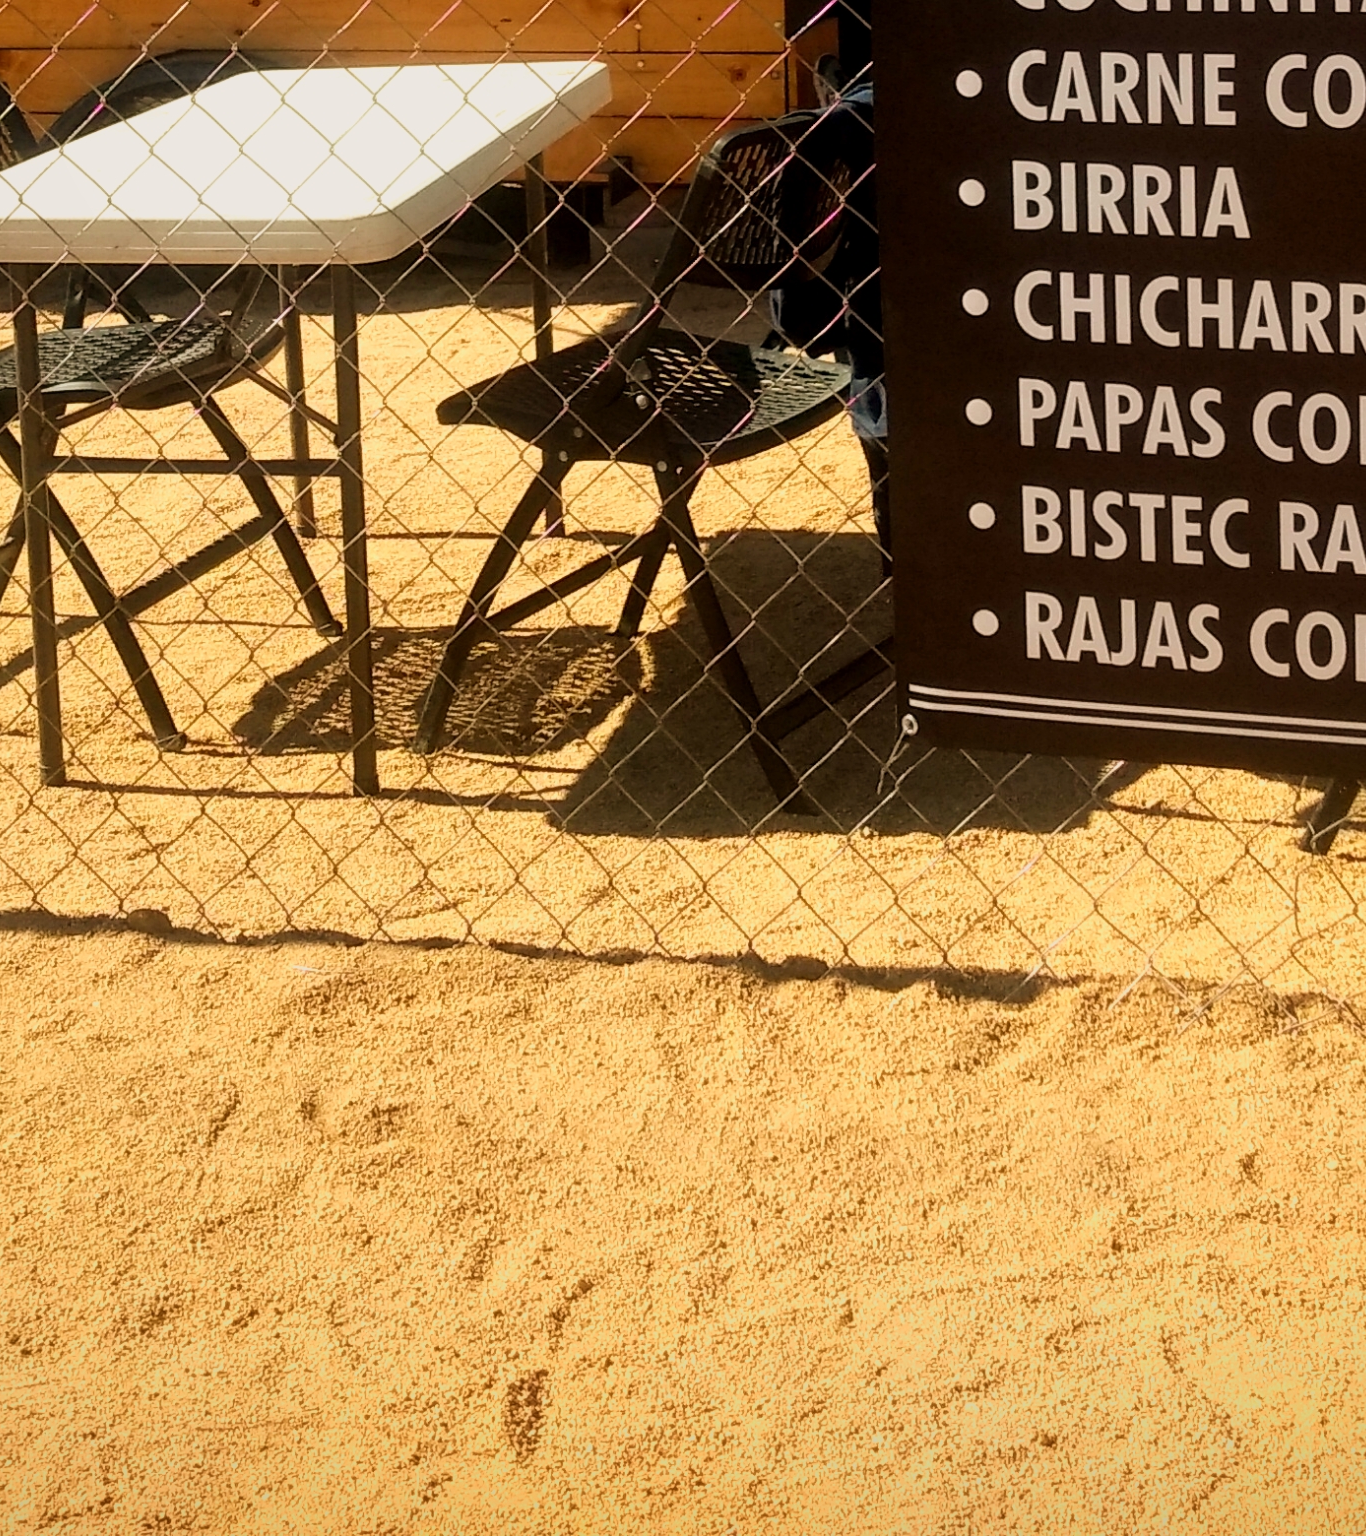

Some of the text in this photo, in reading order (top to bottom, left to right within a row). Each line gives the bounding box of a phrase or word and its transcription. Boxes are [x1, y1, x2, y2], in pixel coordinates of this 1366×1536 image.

[1008, 50, 1236, 125] CARNE
[1013, 161, 1250, 238] BIRRIA
[1019, 378, 1225, 457] PAPAS
[1022, 486, 1249, 568] BISTEC
[1026, 592, 1223, 671] RAJAS
